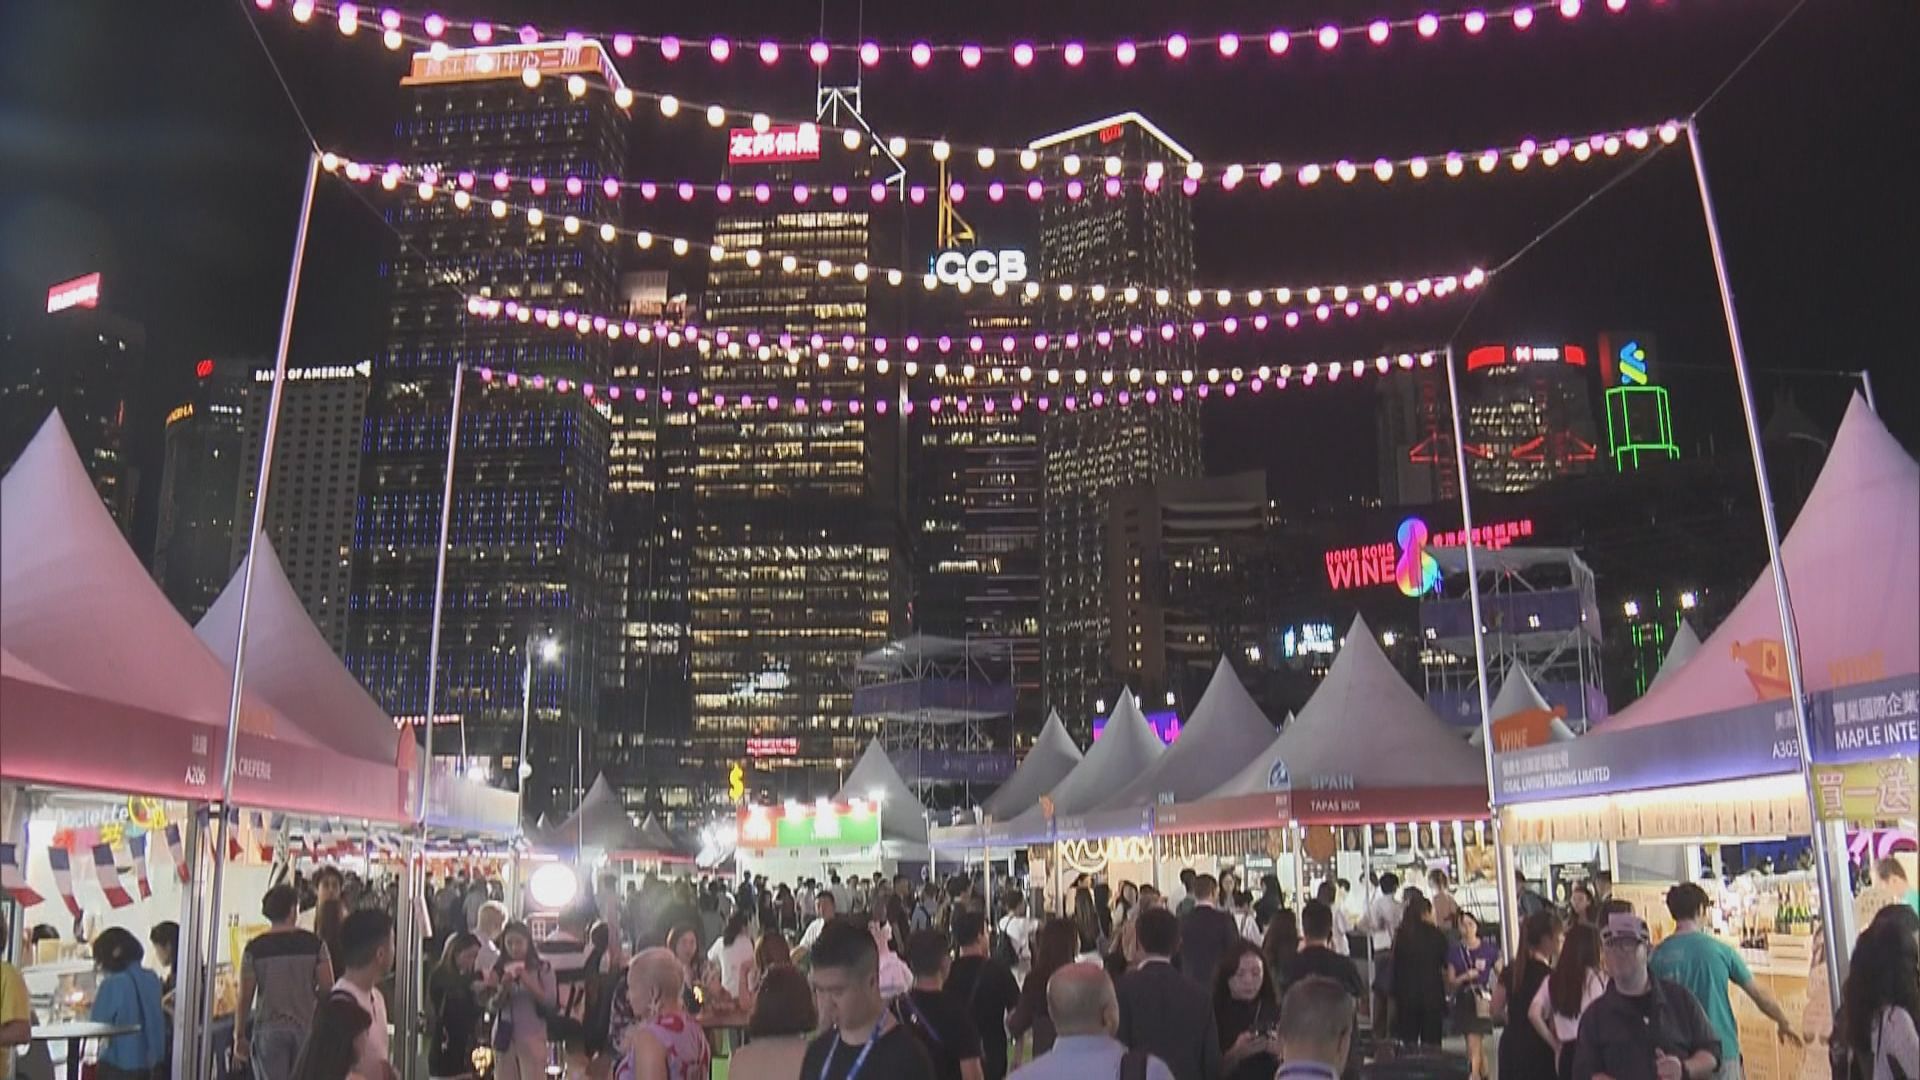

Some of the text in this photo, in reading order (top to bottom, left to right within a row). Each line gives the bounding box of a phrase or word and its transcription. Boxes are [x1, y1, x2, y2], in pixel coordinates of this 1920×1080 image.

[936, 250, 1027, 284] CCB
[255, 365, 354, 381] BAN OF AMERICA
[1325, 541, 1394, 564] HONG KONG
[1327, 555, 1396, 589] WINE
[1835, 720, 1918, 751] MAPLE INTE
[1772, 739, 1799, 759] A303
[184, 766, 206, 785] A206
[1311, 772, 1355, 791] SPAIN
[1544, 768, 1577, 788] TRADING
[1578, 765, 1611, 784] LIMITED
[1816, 762, 1912, 818] 買一送
[1311, 800, 1361, 812] TAPAS BOX
